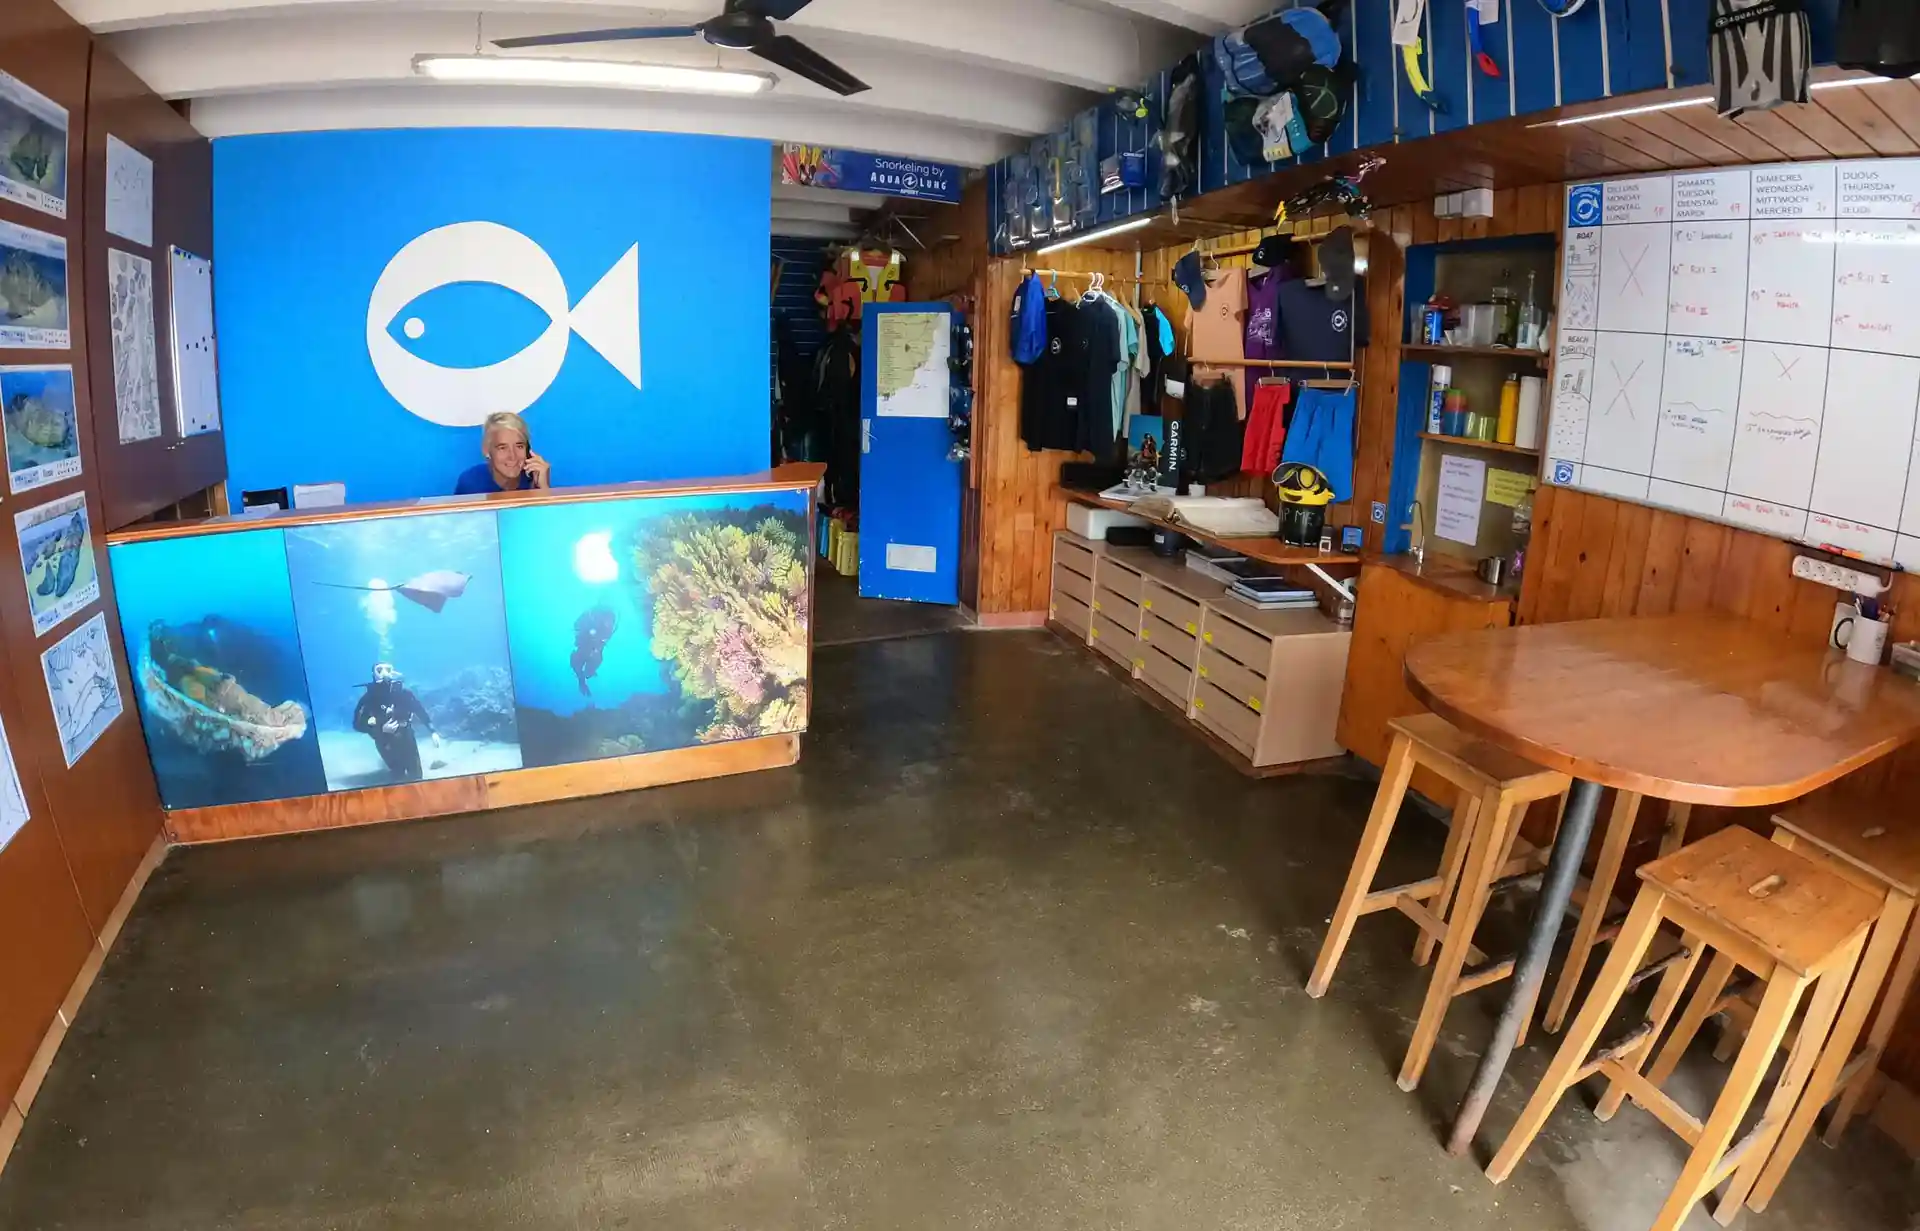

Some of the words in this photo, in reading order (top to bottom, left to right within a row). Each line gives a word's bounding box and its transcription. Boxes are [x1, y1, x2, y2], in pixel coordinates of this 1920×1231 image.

[875, 158, 930, 177] Snorkeling
[931, 164, 945, 177] by
[870, 171, 900, 185] AQUA
[919, 177, 948, 190] LUNG
[1755, 184, 1814, 194] WEDNESDAY
[1843, 182, 1896, 191] THURSDAY
[1678, 189, 1715, 197] TUESDAY
[1607, 194, 1641, 202] MONDAY
[1755, 195, 1809, 204] MITTWOCH
[1842, 194, 1913, 203] DONNERSTAG
[1756, 206, 1803, 215] MERCREDI
[1294, 509, 1316, 526] ME
